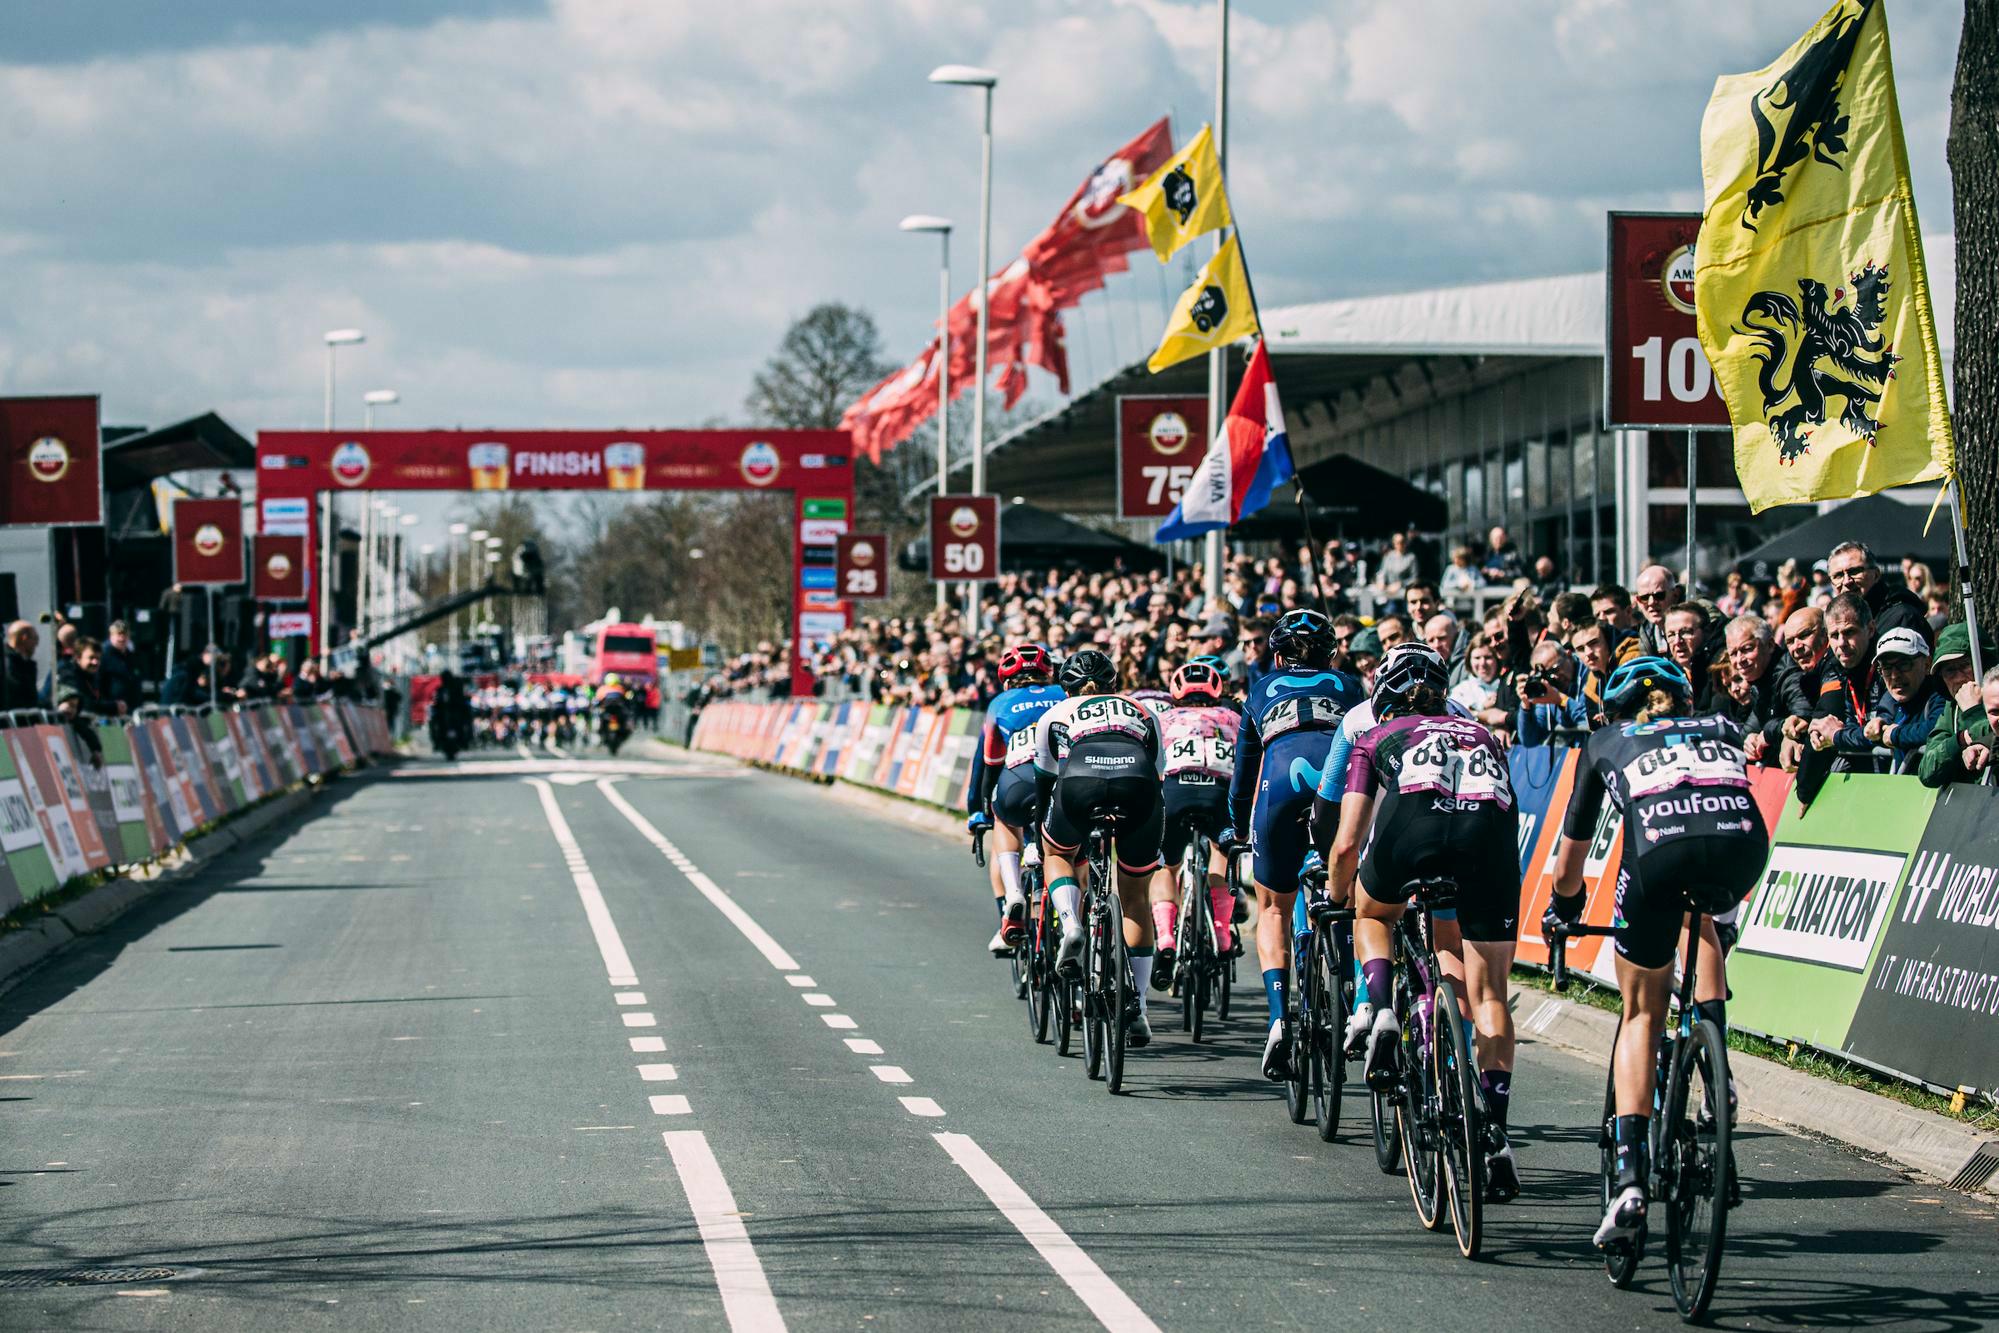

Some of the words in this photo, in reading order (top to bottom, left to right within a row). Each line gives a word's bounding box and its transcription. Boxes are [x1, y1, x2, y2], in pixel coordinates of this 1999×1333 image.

[1632, 336, 1727, 403] 10
[514, 450, 601, 477] FINISH
[1141, 465, 1194, 505] 75
[943, 543, 984, 573] 50
[846, 569, 878, 594] 25
[1264, 699, 1292, 722] 42
[1084, 755, 1136, 765] SHIMANO
[1173, 740, 1196, 758] 54
[1215, 741, 1235, 763] 54
[1183, 773, 1199, 781] svb
[1638, 792, 1750, 827] youfone
[1659, 825, 1685, 837] Nalini
[1717, 821, 1741, 831] Nalini
[1615, 868, 1631, 906] DSM
[1936, 862, 1999, 931] WORLD
[1875, 954, 1897, 990] IT
